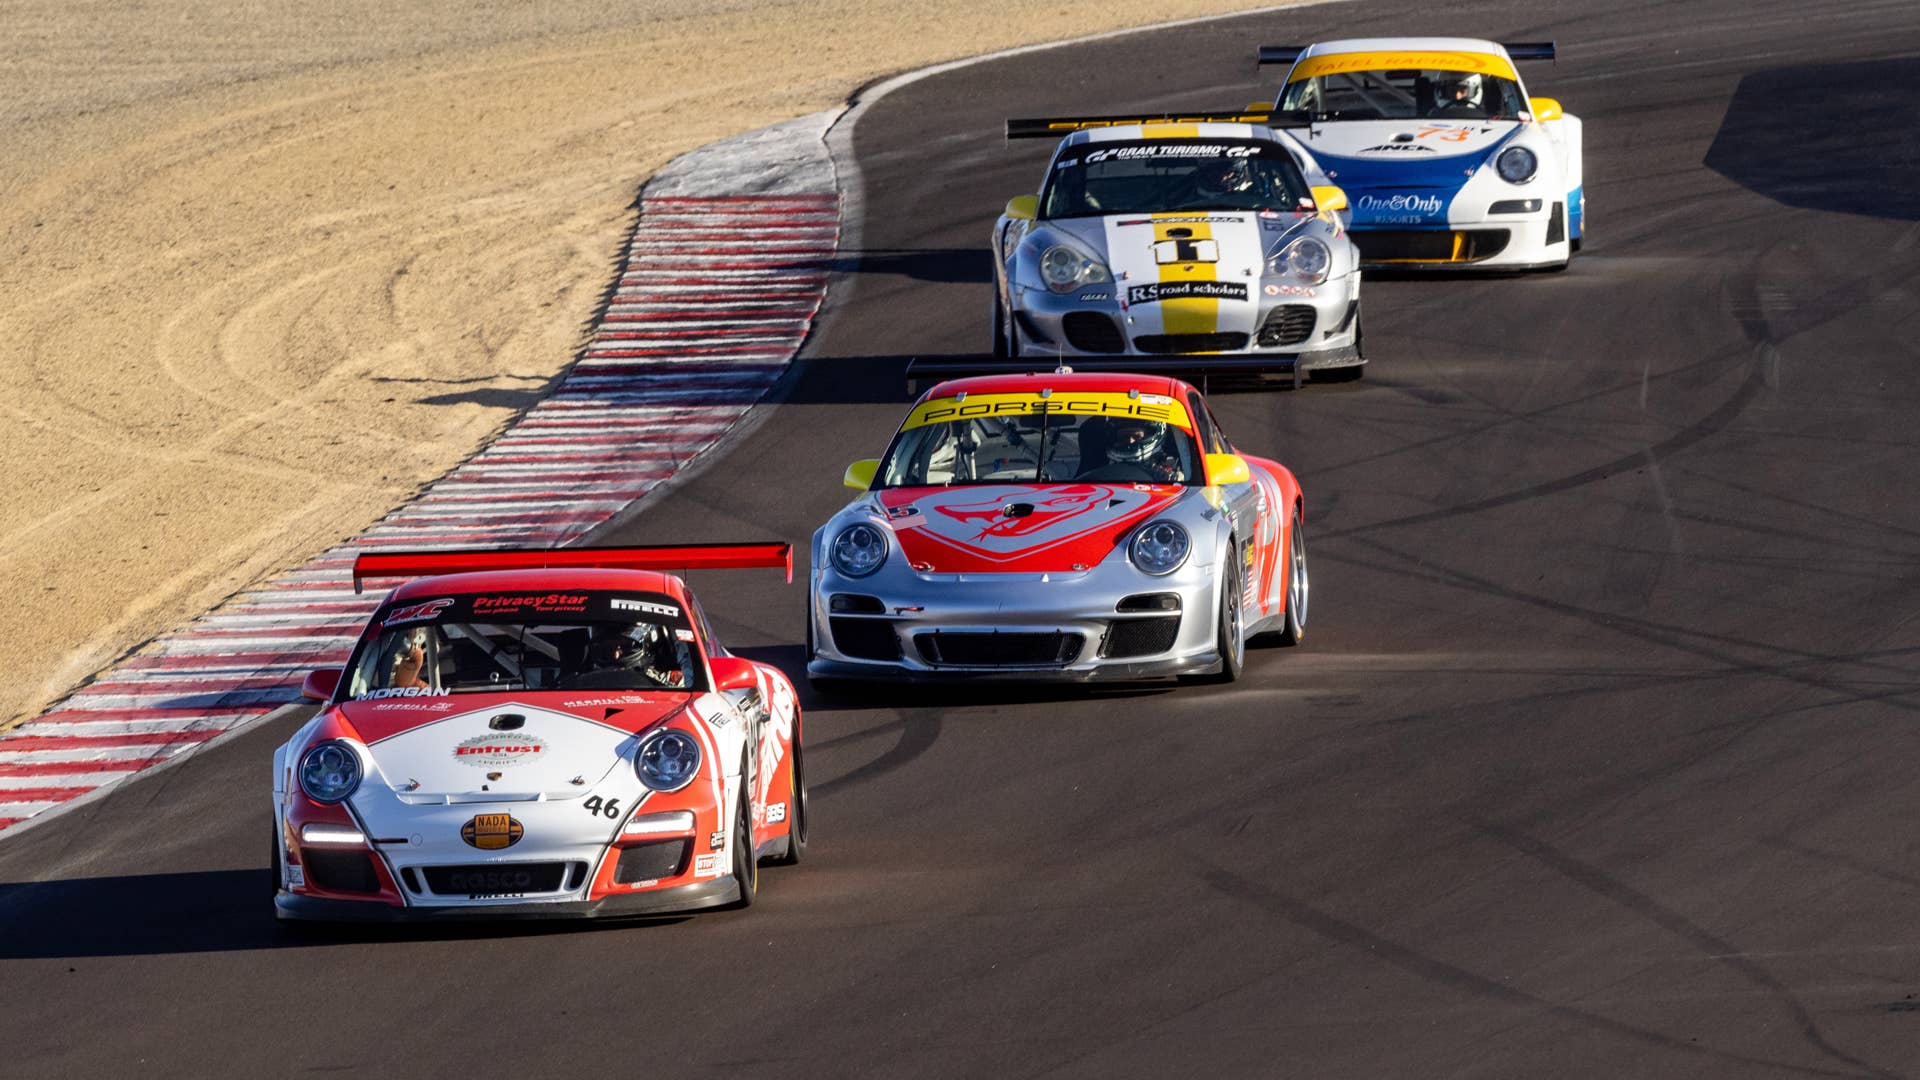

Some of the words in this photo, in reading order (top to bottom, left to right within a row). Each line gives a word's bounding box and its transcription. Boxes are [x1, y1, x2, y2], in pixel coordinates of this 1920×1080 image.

[1315, 58, 1373, 72] TAFEL
[1384, 57, 1471, 67] RACING
[1116, 146, 1158, 158] GRAN
[1358, 194, 1443, 217] One&Only
[1131, 284, 1158, 302] RS
[1160, 283, 1190, 295] road
[1193, 283, 1247, 296] scholars
[923, 400, 1171, 422] PORSCHE
[473, 594, 588, 608] PrivacyStar
[610, 599, 679, 618] PIRELLI
[355, 686, 451, 701] MORGAN
[456, 744, 542, 756] Entrust
[583, 794, 621, 820] 46
[478, 816, 506, 826] NADA
